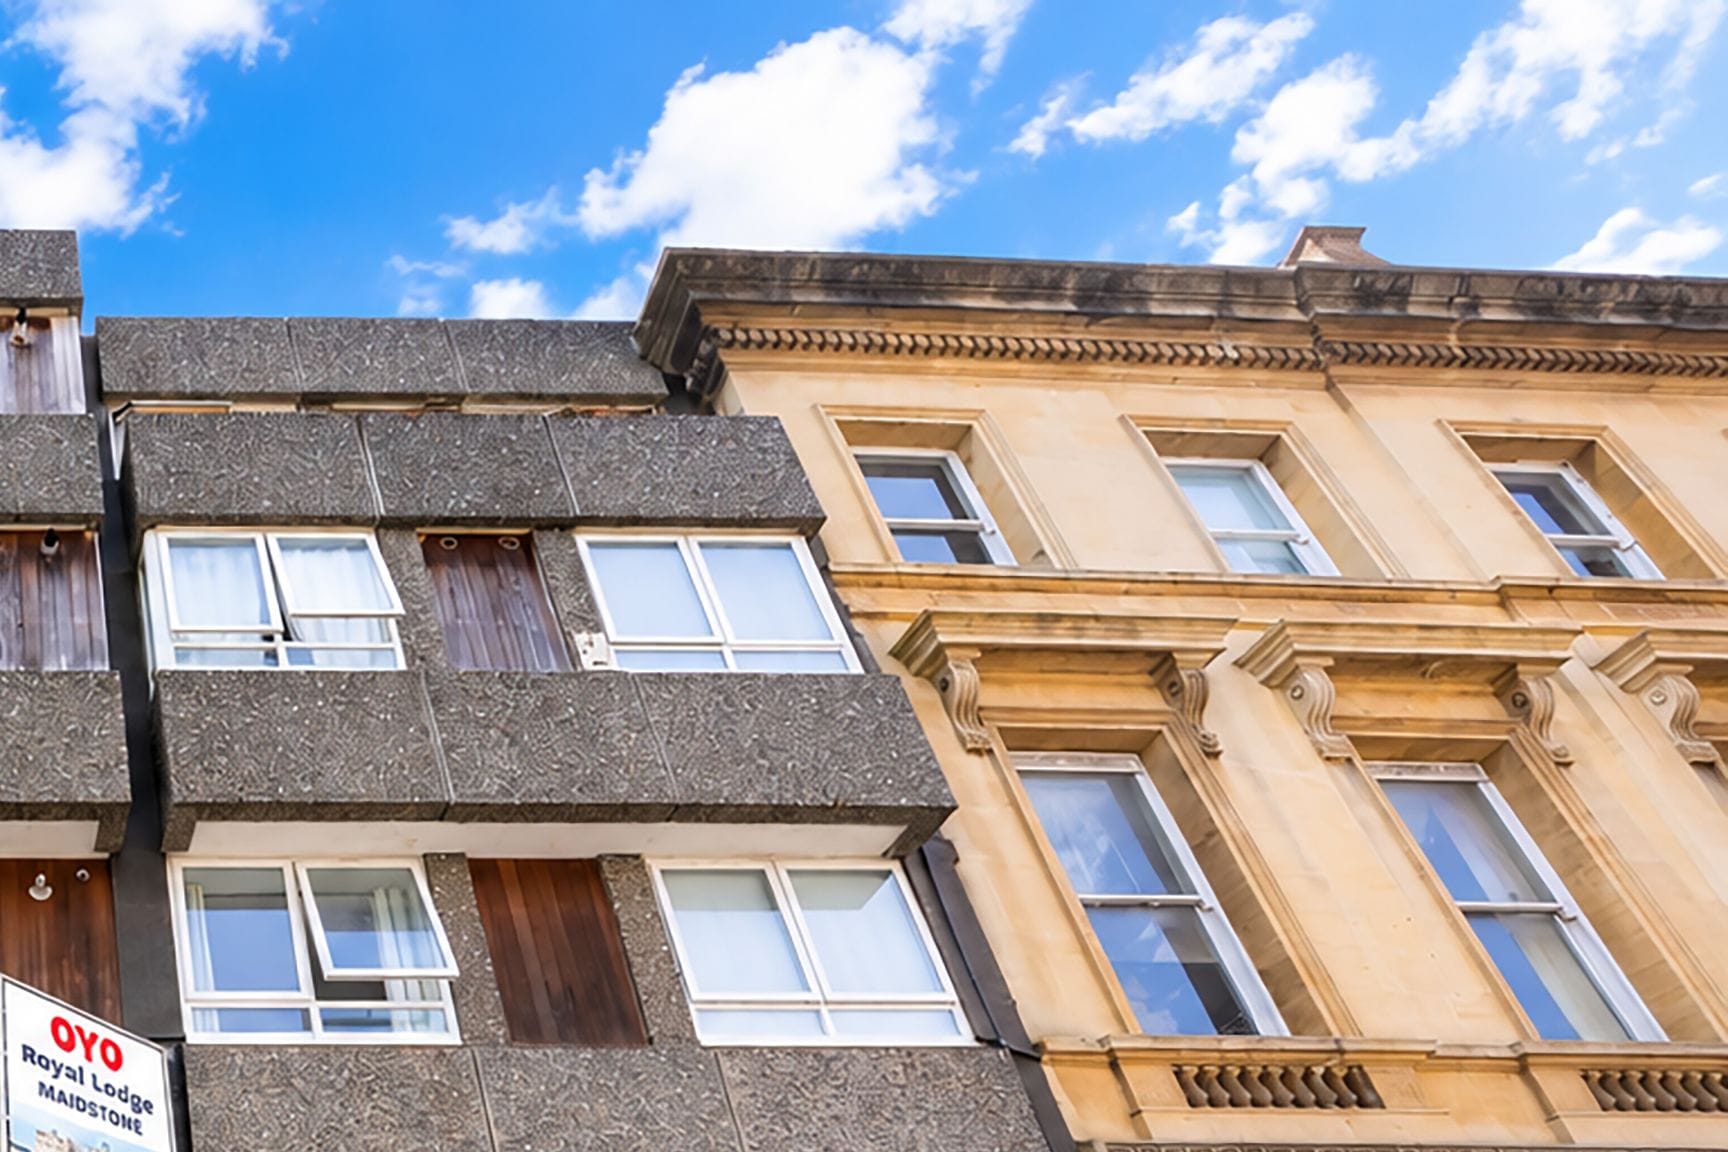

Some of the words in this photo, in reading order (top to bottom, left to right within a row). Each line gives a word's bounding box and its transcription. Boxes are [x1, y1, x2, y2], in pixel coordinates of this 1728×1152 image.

[50, 1016, 123, 1072] OYO
[21, 1044, 84, 1085] Royal
[91, 1073, 154, 1115] Lodge
[38, 1081, 143, 1136] MAIDSTONE
